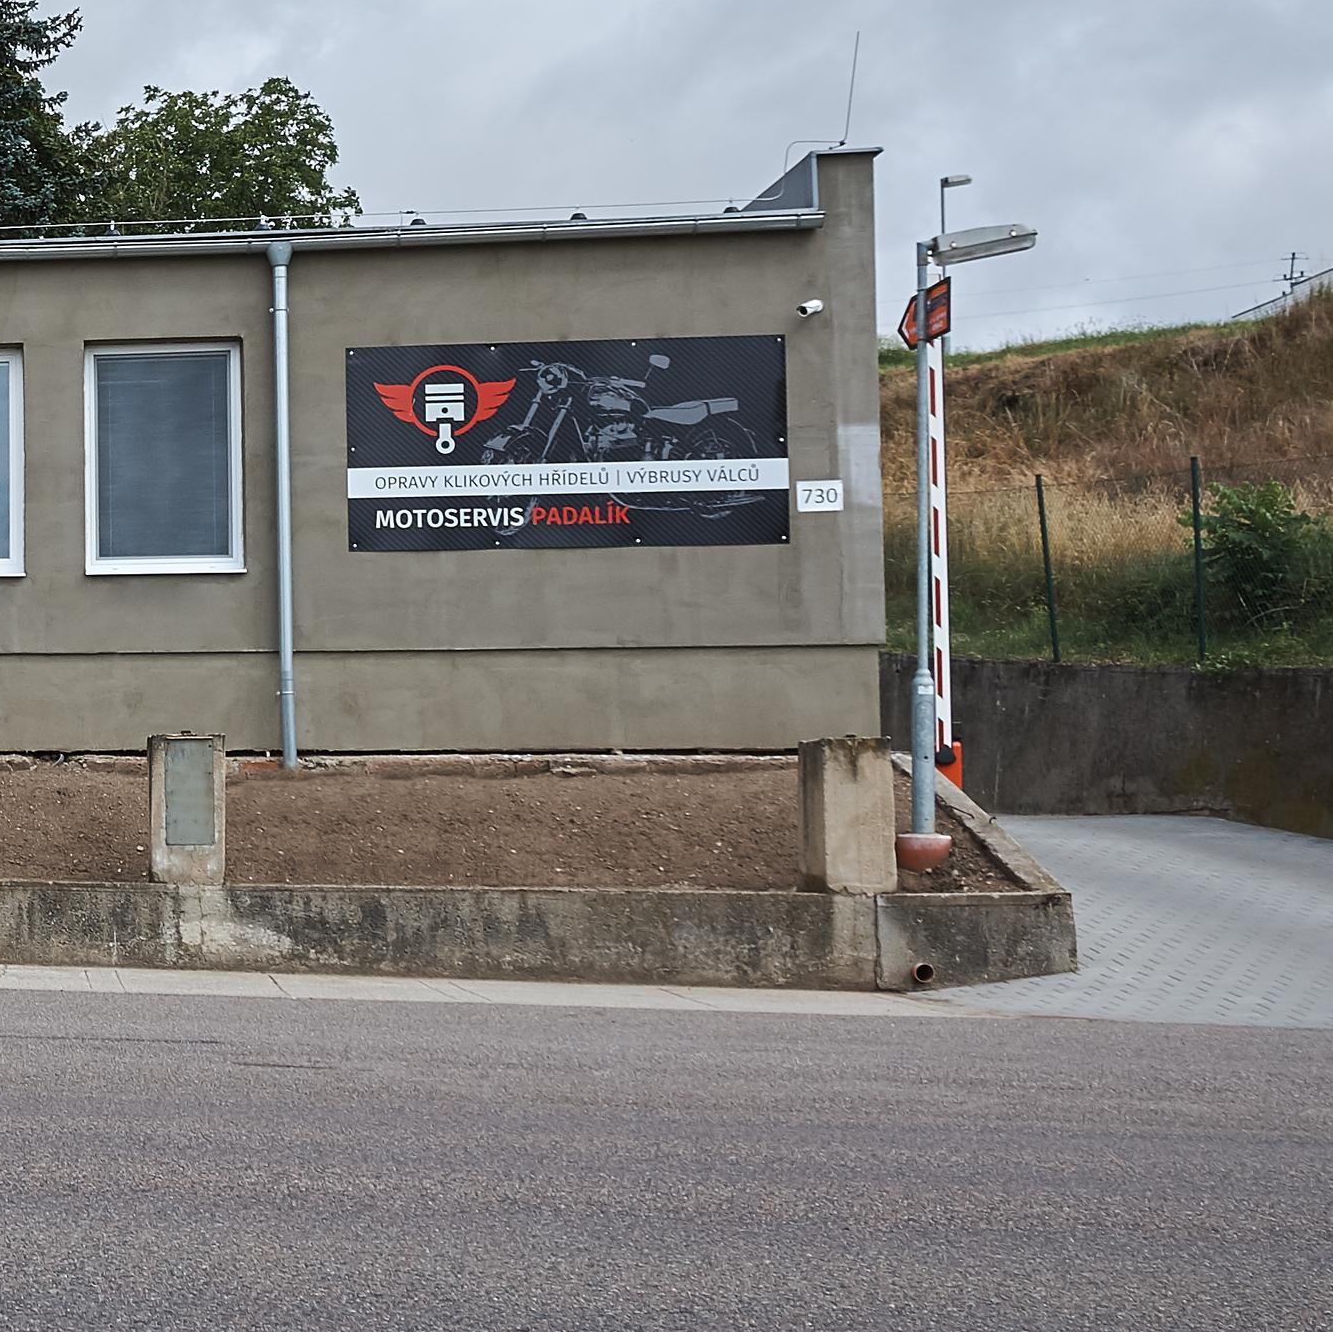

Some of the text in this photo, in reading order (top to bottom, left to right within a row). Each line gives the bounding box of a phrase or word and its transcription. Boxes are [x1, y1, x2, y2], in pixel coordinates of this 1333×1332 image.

[374, 475, 438, 490] OPRAVY
[443, 470, 532, 488] KLIKOVÝCH
[539, 467, 609, 486] HŘÍDELŮ
[627, 467, 702, 484] VÝBRUSY
[706, 463, 759, 483] VÁLCŮ
[801, 487, 838, 504] 730
[375, 499, 631, 529] MOTOSERVIS PADALÍK
